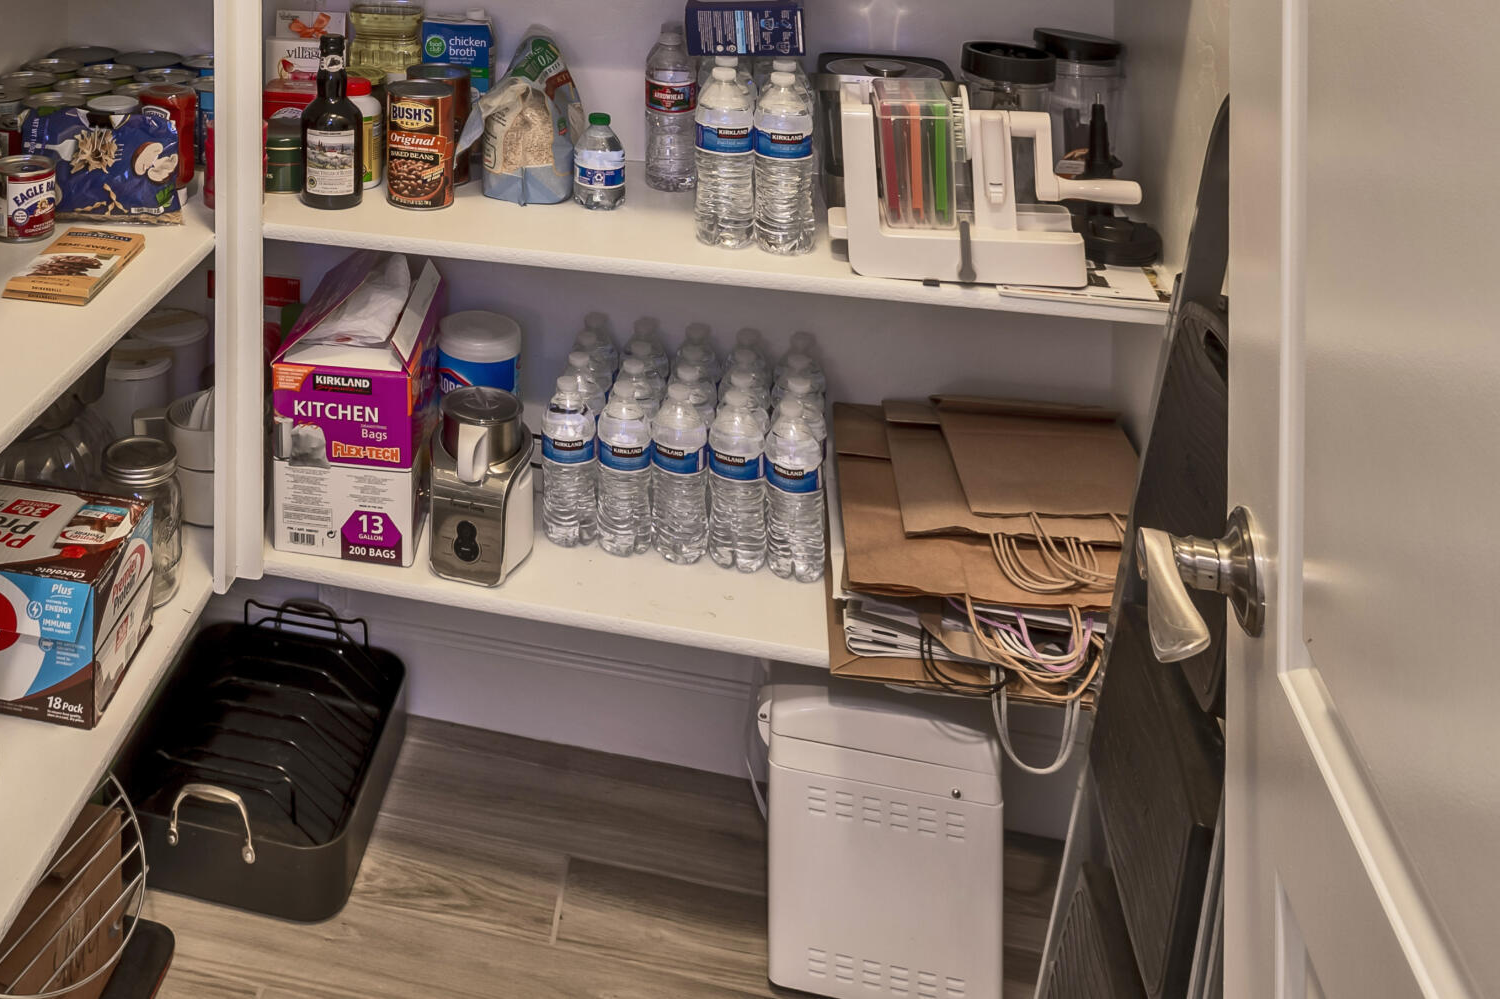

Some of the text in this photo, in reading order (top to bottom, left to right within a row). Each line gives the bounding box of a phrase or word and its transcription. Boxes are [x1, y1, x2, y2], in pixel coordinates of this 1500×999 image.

[449, 36, 487, 48] chicken
[449, 47, 477, 57] broth
[654, 92, 684, 101] ARROWHEAD
[392, 106, 433, 123] BUSH'S
[390, 133, 436, 147] Original
[410, 151, 435, 160] BEANS
[12, 183, 44, 207] EAGLE
[315, 374, 371, 388] KIRKLAND
[293, 399, 380, 423] KITCHEN
[361, 427, 388, 442] Bags
[554, 440, 583, 448] KIRKLAND
[332, 440, 401, 463] FLEX-TECH
[613, 447, 642, 455] KIRKLAND
[657, 445, 684, 458] KIRKLAND
[715, 452, 745, 464] KIRKLAND
[774, 464, 804, 477] KIRKLAND
[358, 513, 385, 536] 13
[358, 533, 384, 542] GALLON
[348, 545, 397, 560] 200 BAGS
[34, 566, 86, 580] Chocolate
[51, 583, 74, 597] Plus
[44, 604, 74, 614] ENERGY
[42, 618, 72, 630] IMMUNE
[46, 695, 85, 714] 18 Pack
